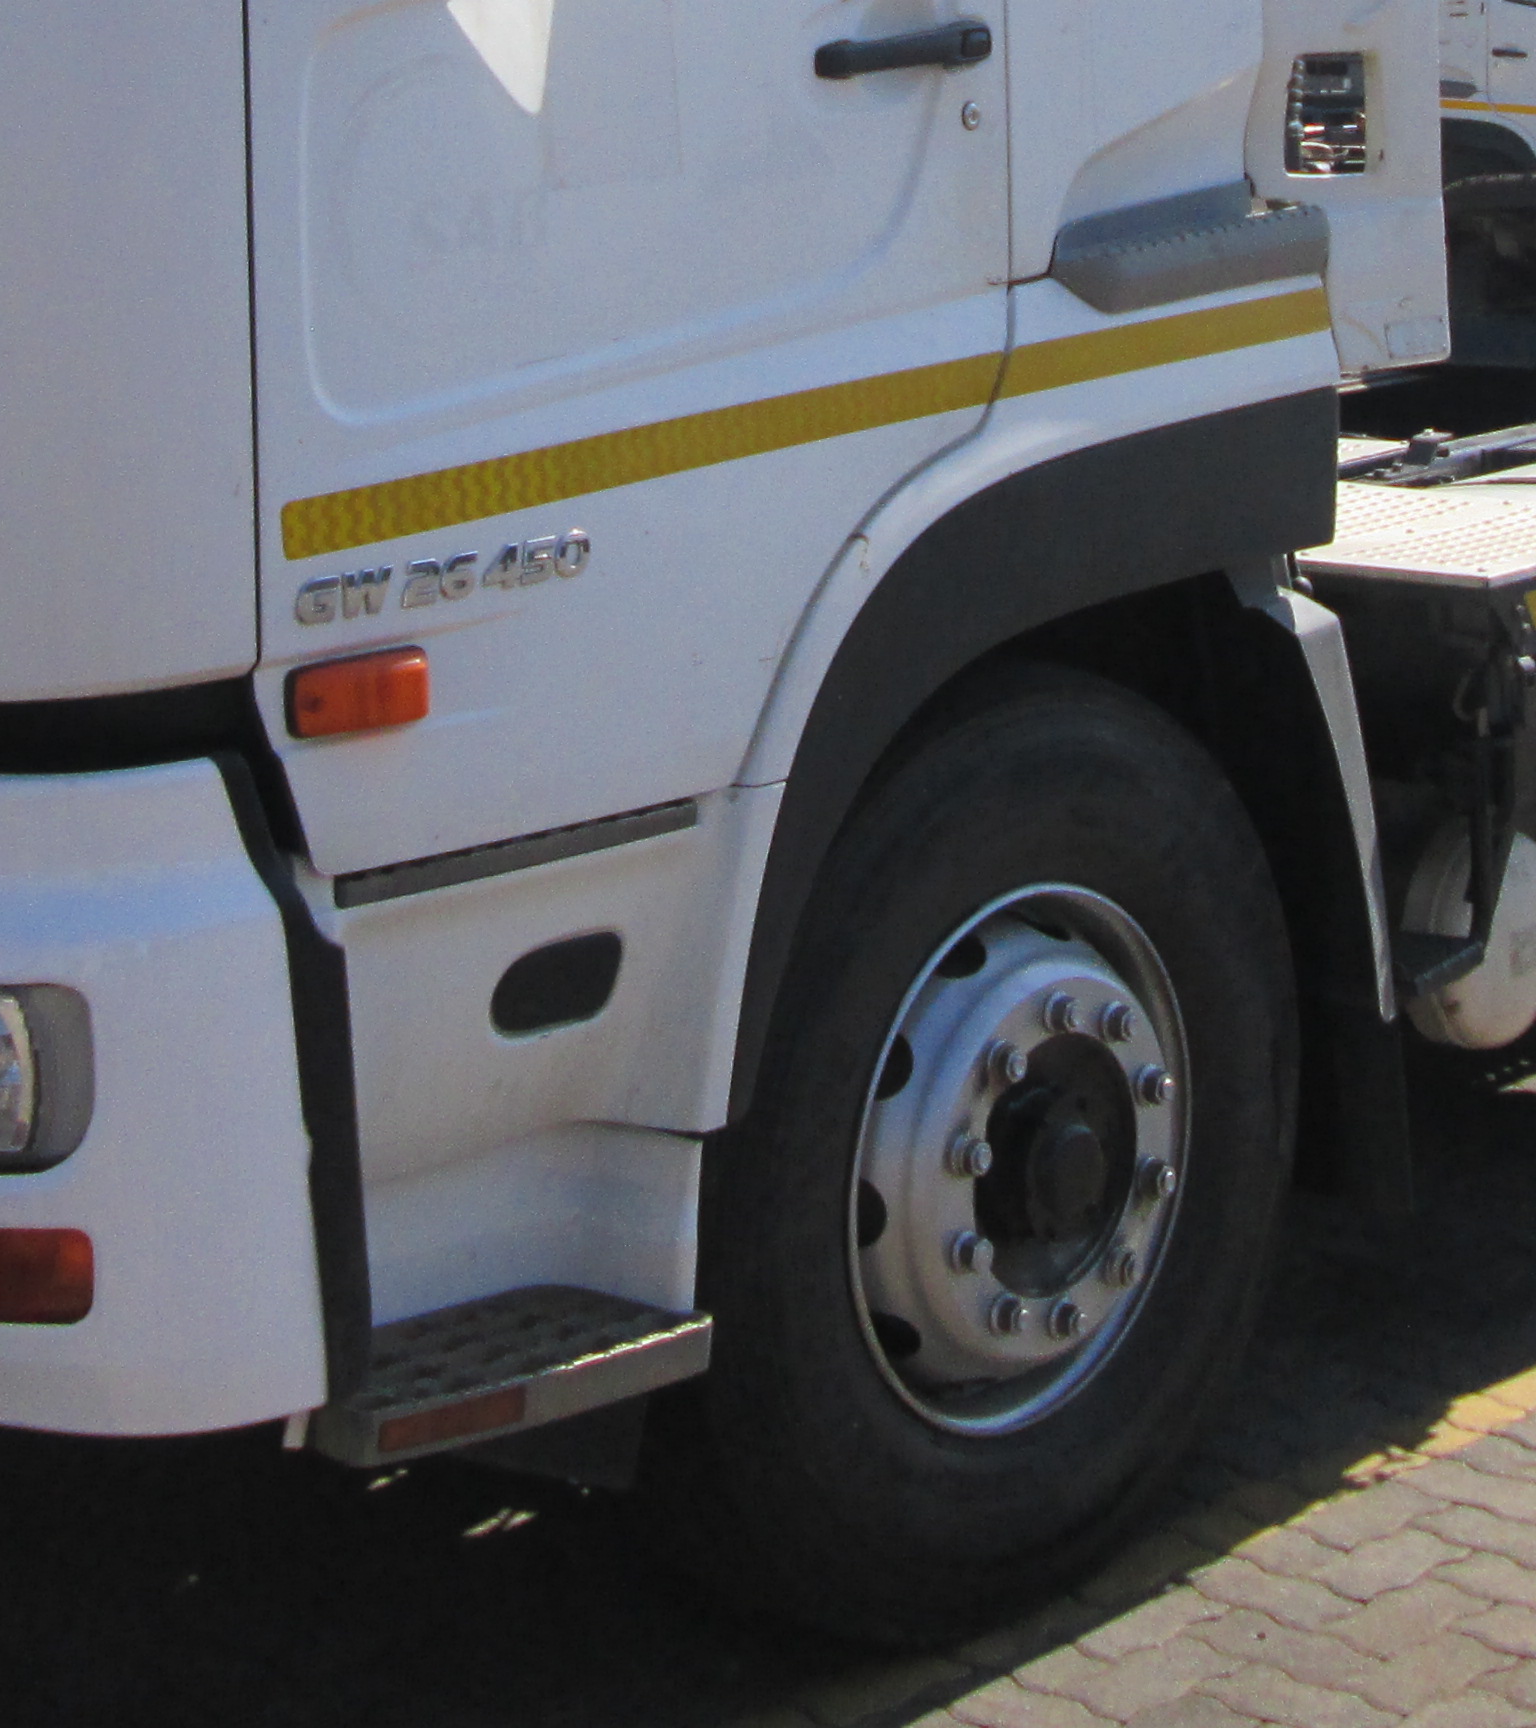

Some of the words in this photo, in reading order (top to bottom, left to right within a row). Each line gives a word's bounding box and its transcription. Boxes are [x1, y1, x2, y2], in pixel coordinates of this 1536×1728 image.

[294, 565, 395, 625] GW
[400, 550, 478, 610] 26
[481, 527, 592, 590] 450
